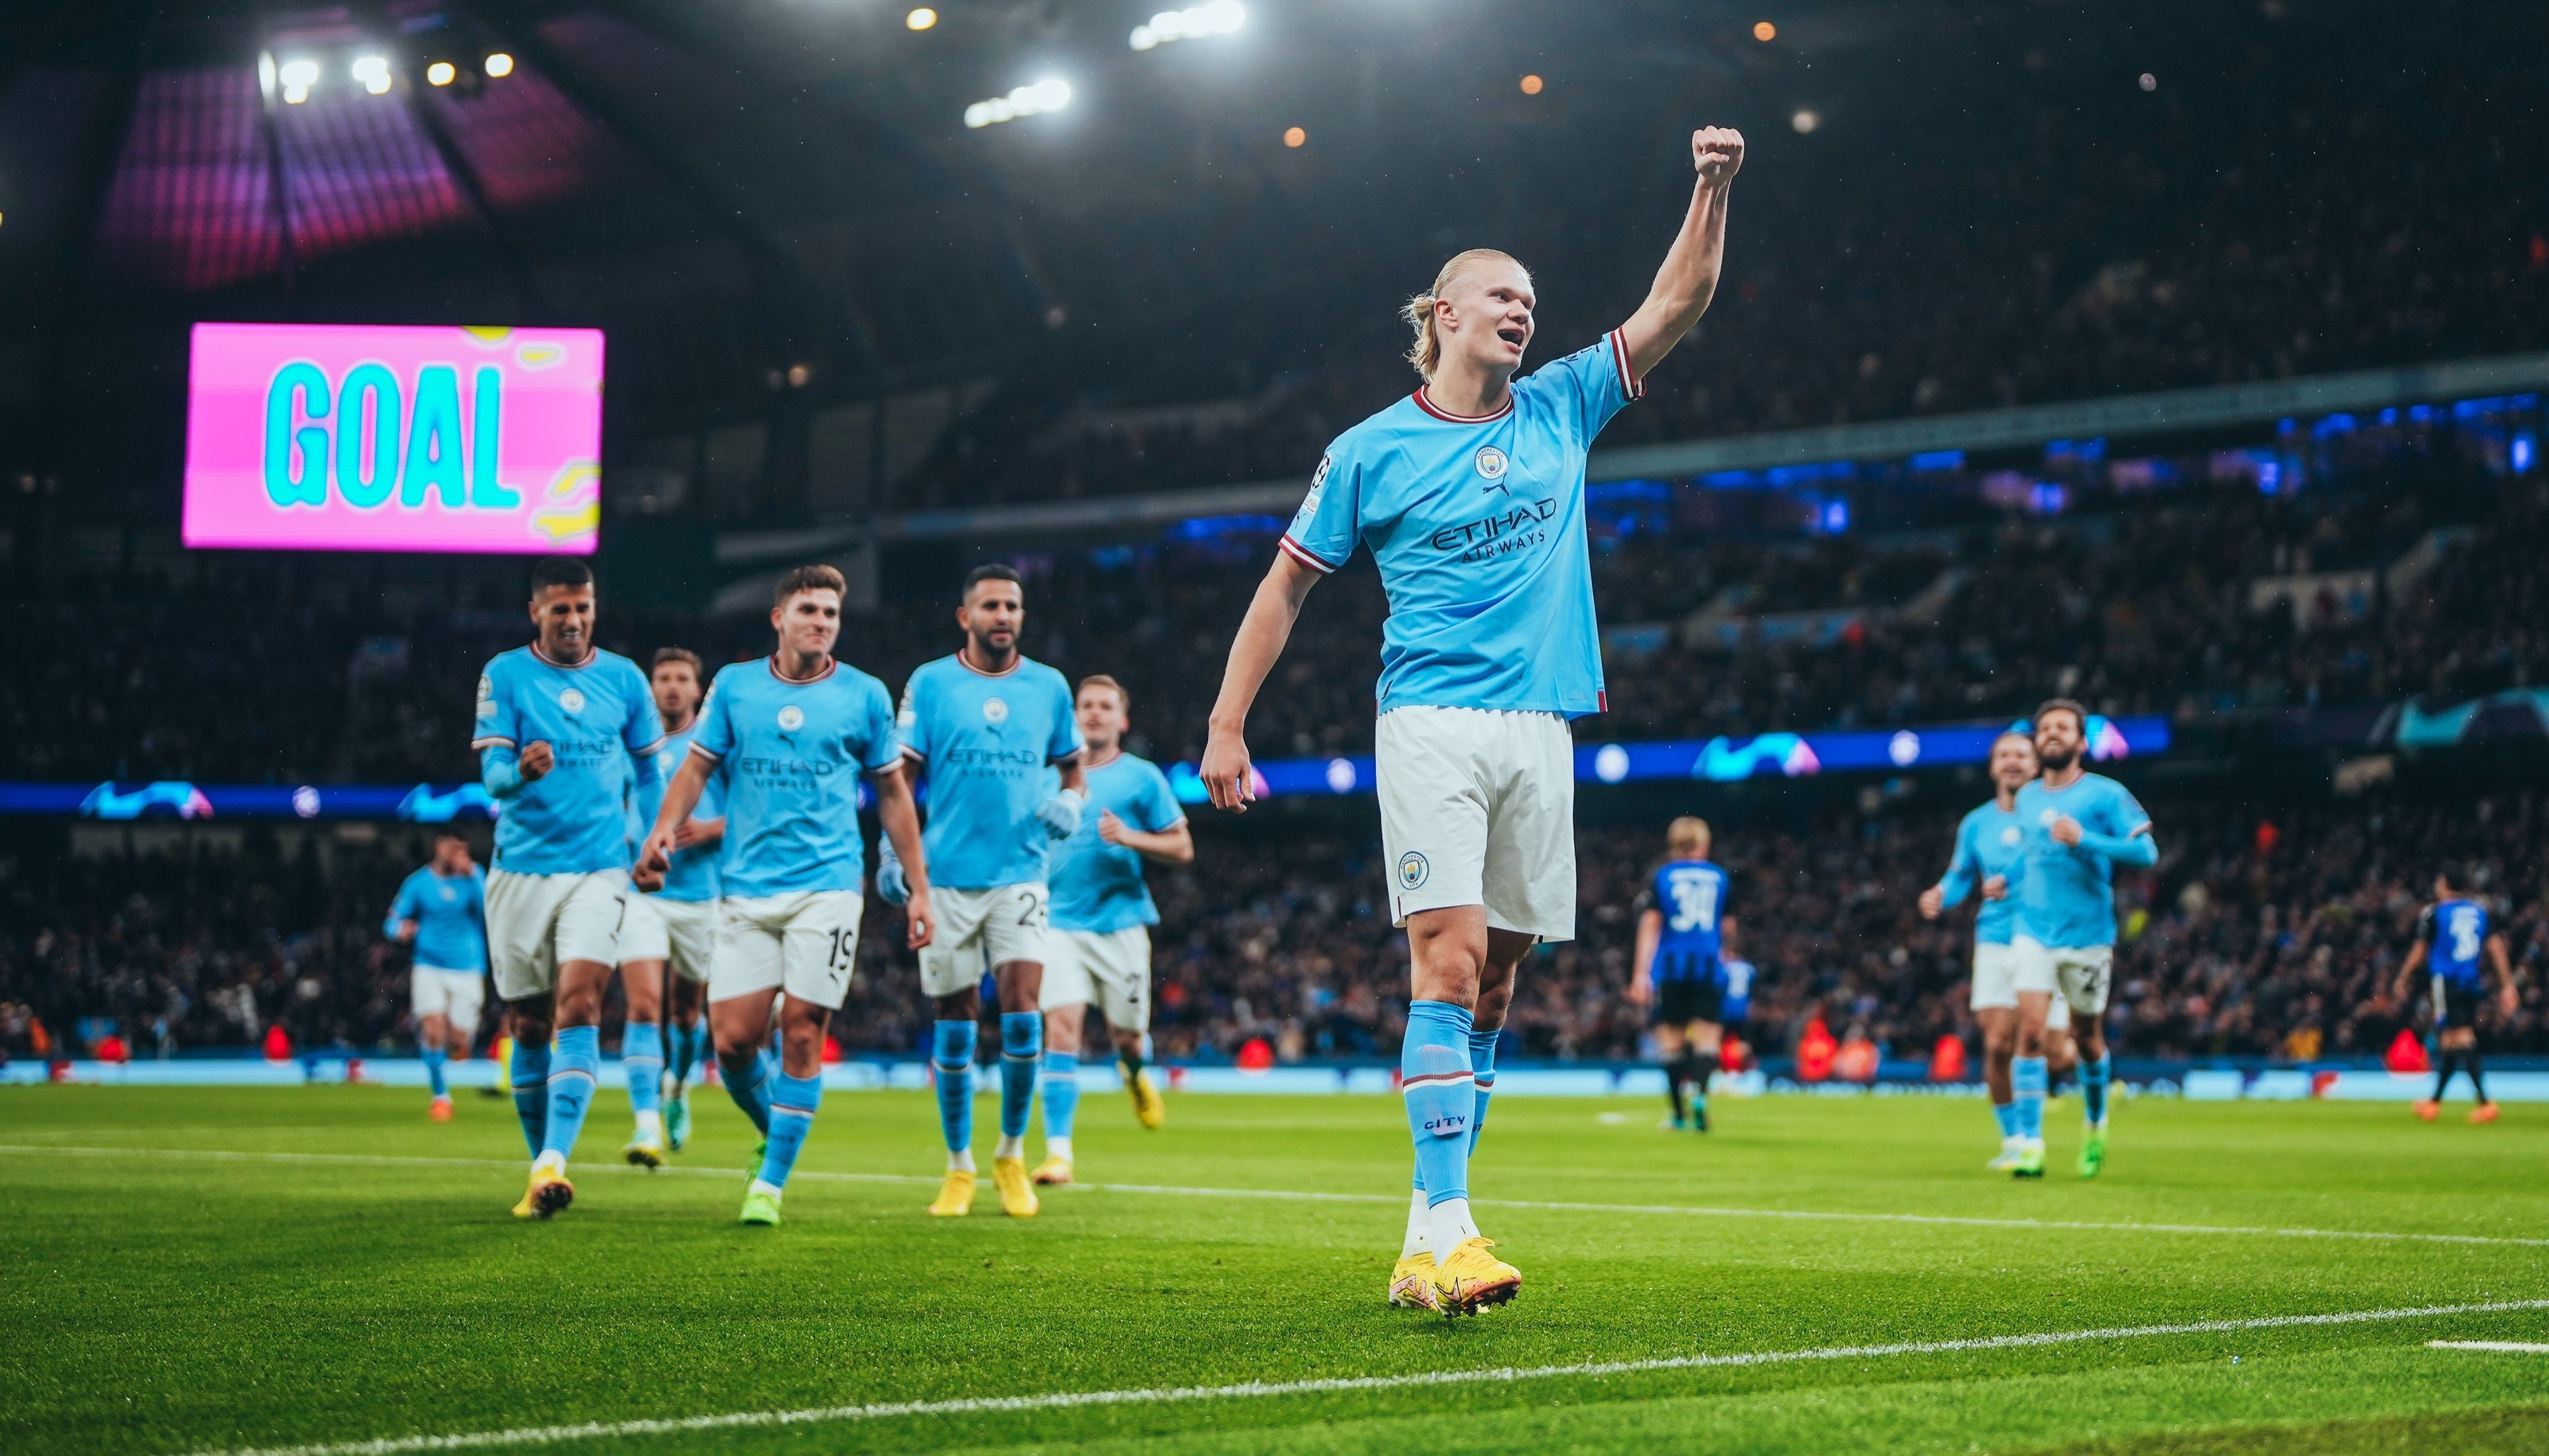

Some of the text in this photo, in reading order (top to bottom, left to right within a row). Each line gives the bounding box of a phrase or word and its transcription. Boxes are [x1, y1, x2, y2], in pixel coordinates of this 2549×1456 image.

[265, 361, 521, 508] GOAL
[1477, 447, 1504, 459] MANCHESTER
[1432, 497, 1556, 551] ETIHAD
[1462, 529, 1545, 564] AIRWAYS
[947, 748, 1037, 764] ETIHAD
[741, 758, 833, 776] ETIHAD
[1401, 854, 1424, 869] MANCHESTER
[828, 926, 853, 971] 19
[1424, 1116, 1465, 1130] CITY
[1472, 1123, 1483, 1132] IT
